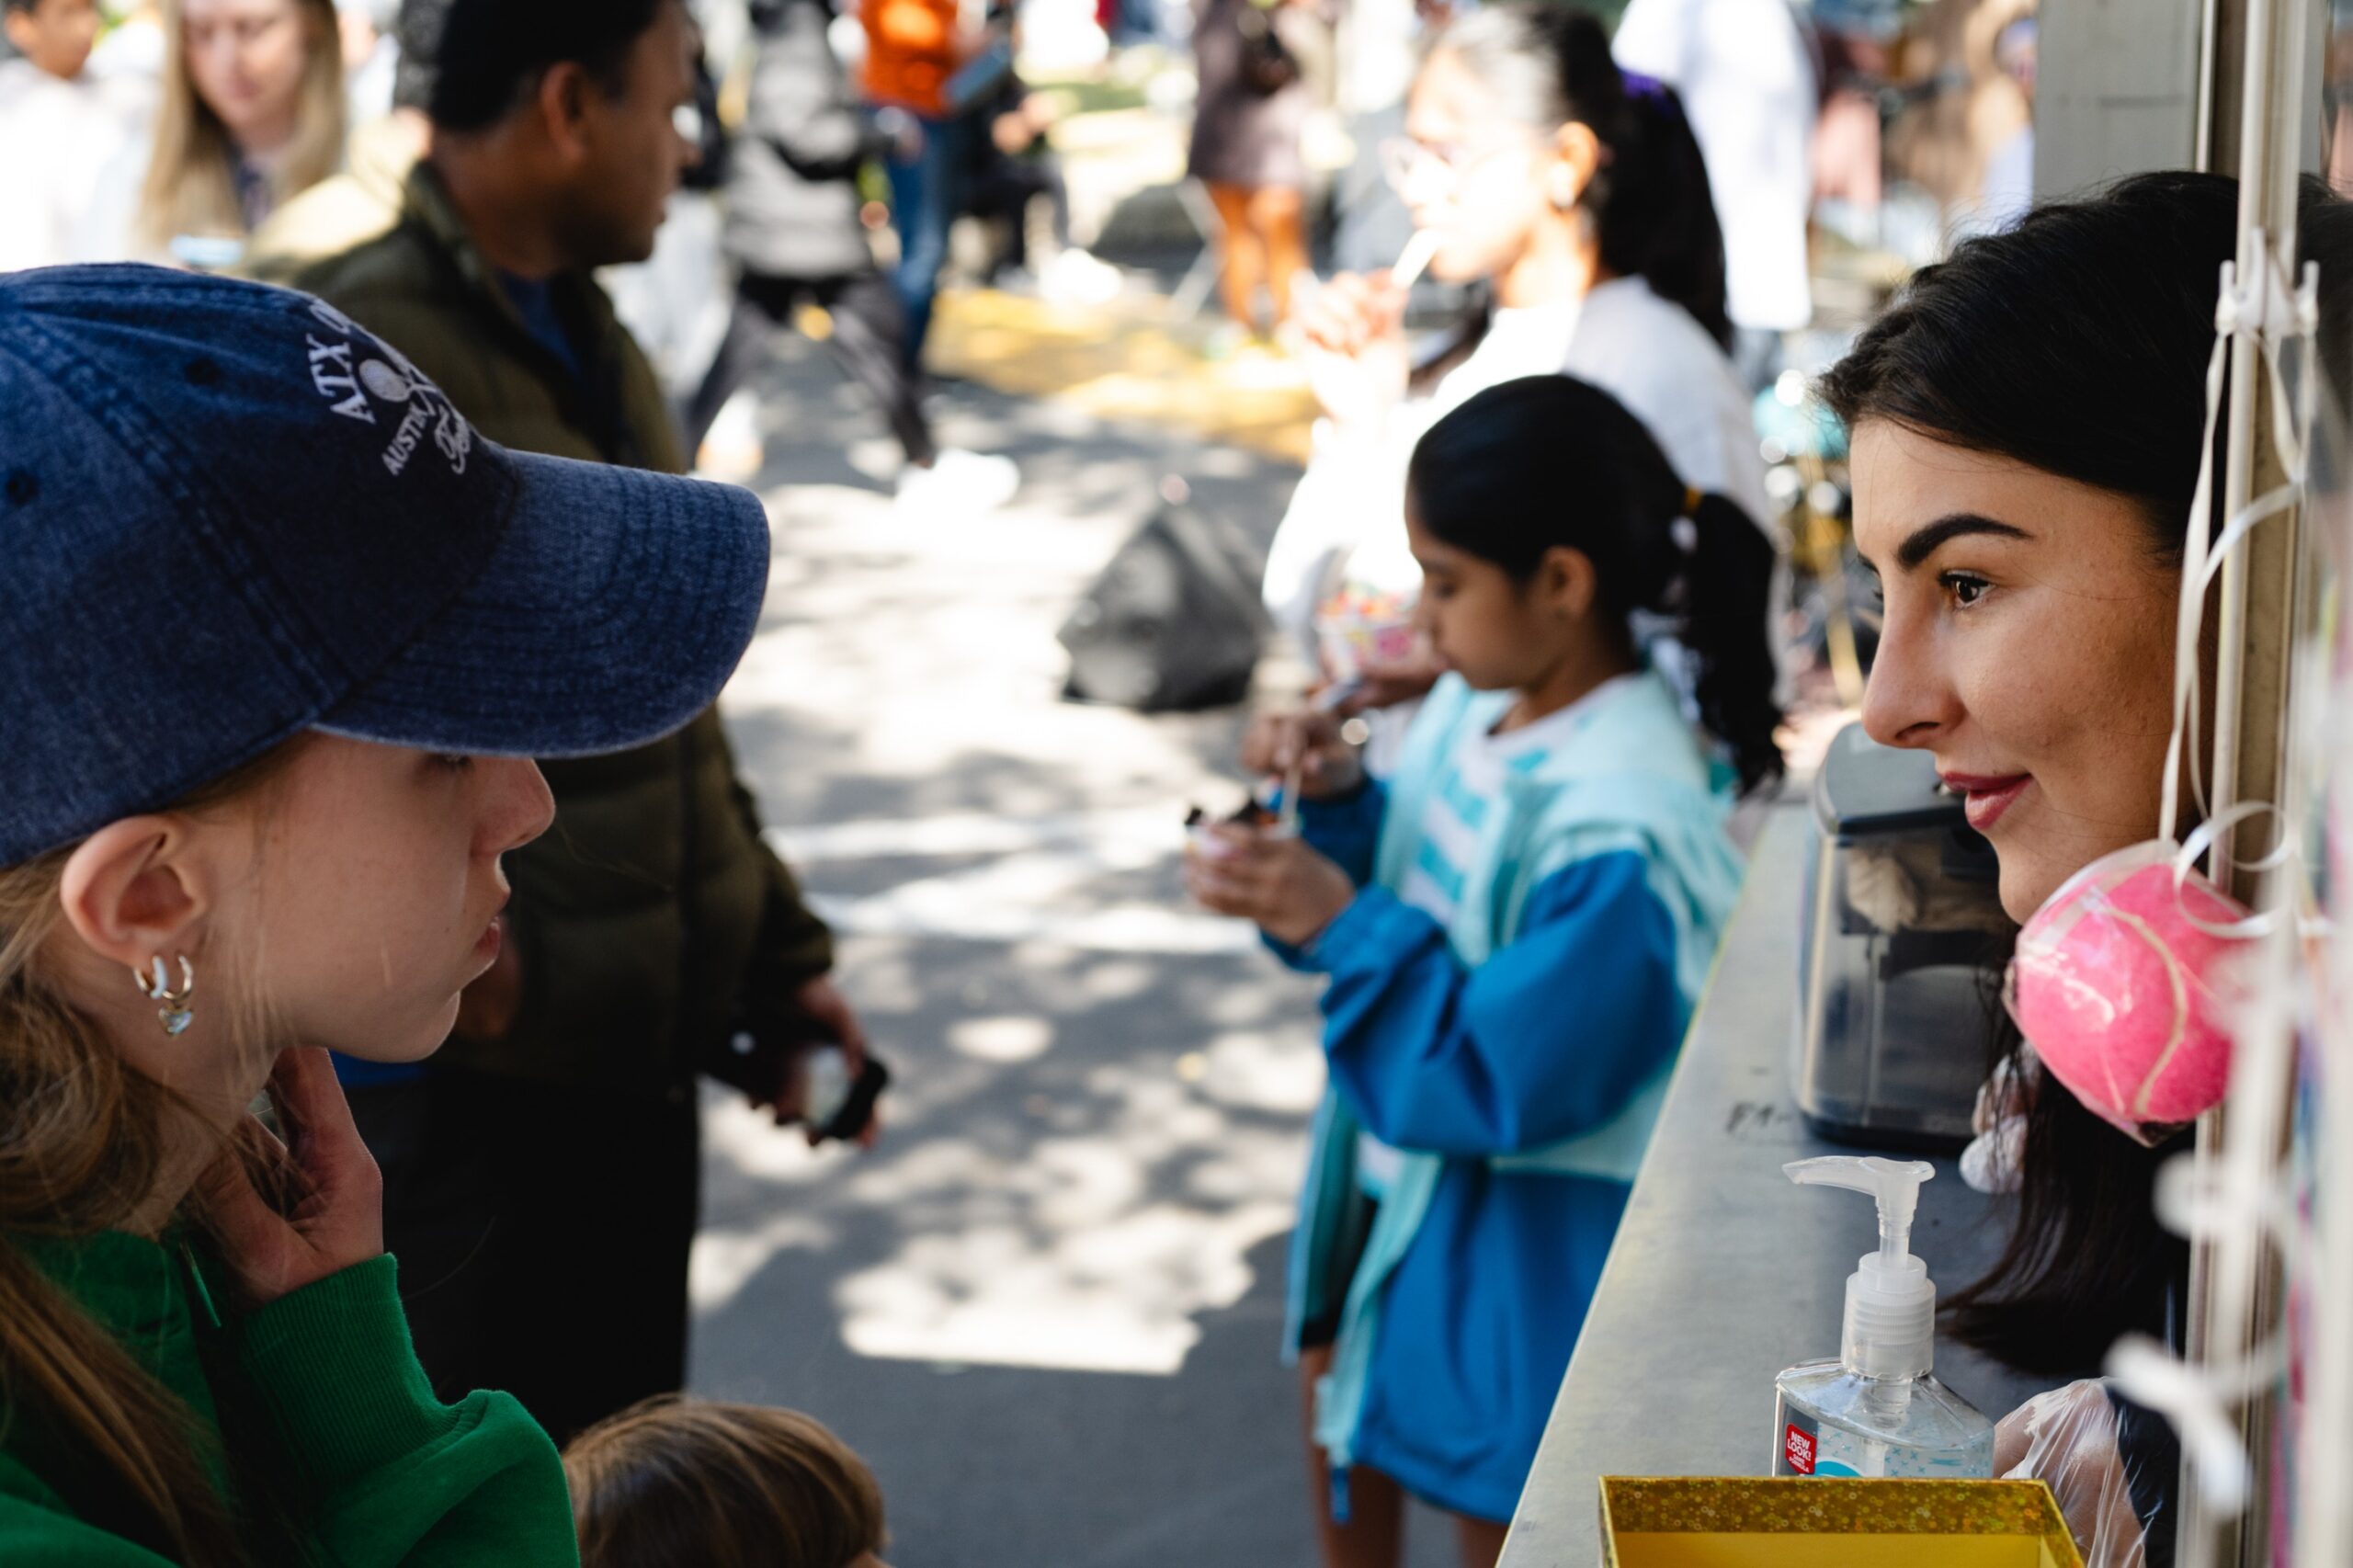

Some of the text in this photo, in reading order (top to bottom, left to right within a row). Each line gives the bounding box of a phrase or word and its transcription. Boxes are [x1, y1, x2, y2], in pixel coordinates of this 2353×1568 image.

[305, 332, 376, 425] ATX
[381, 401, 431, 476] AUSTIN
[1787, 1437, 1812, 1461] LOOK!
[1790, 1430, 1811, 1450] NEW
